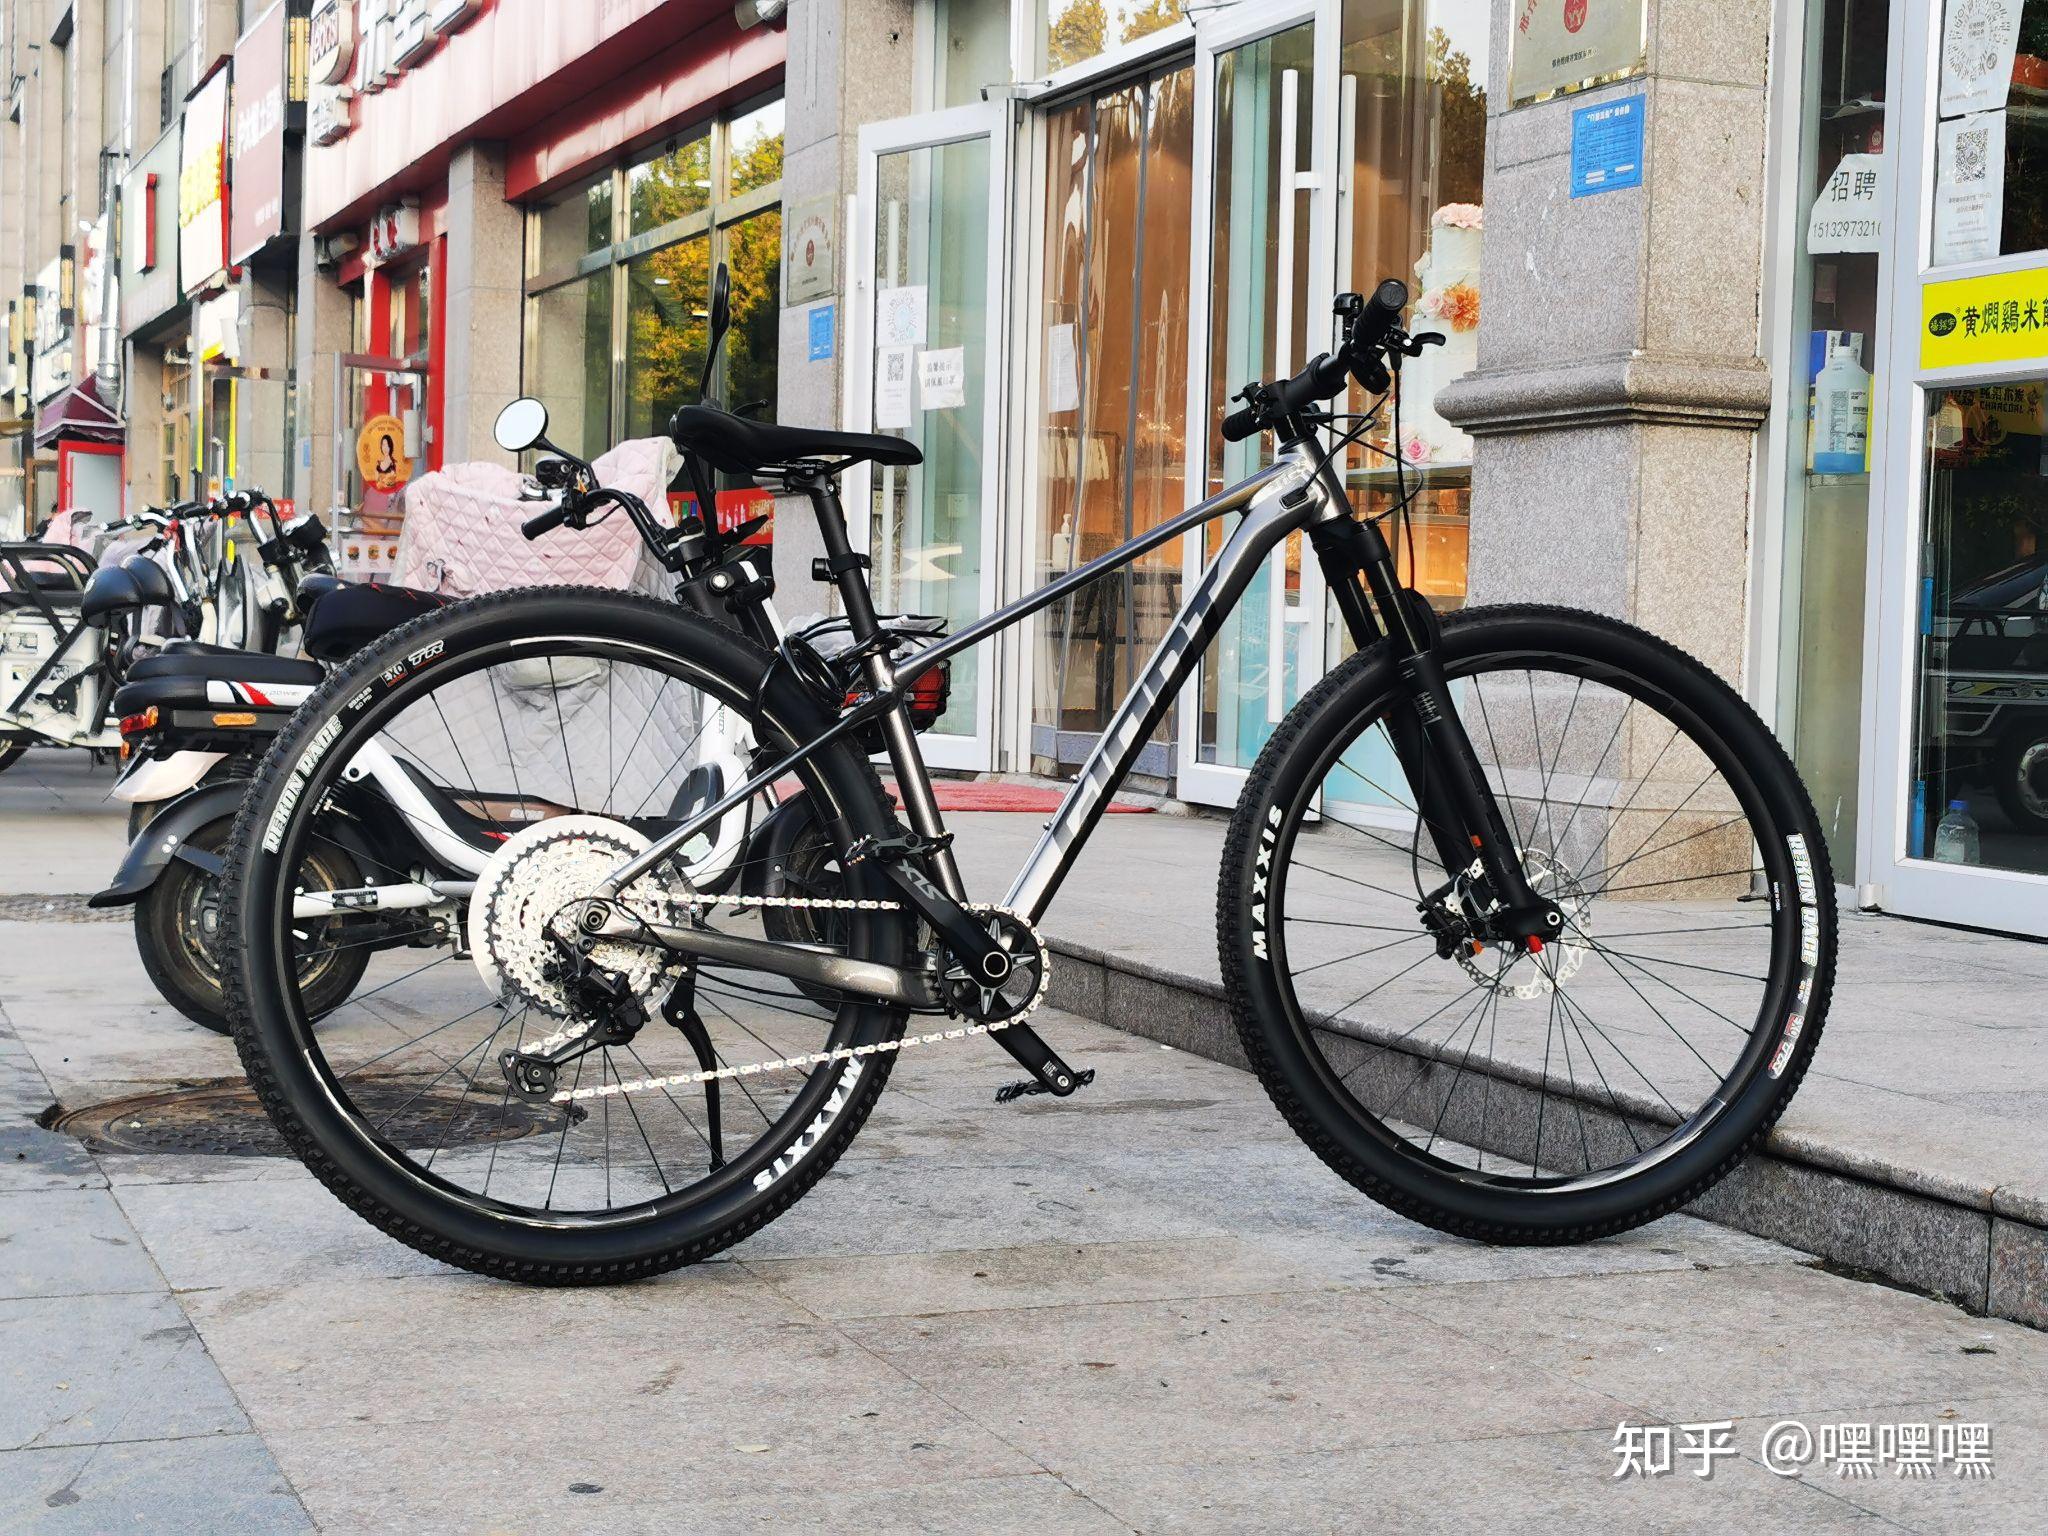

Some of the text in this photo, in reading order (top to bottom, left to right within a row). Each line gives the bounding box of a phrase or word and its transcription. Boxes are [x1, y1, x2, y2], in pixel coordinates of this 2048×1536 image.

[1831, 169, 1877, 202] 招聘
[262, 714, 344, 854] REKON RACE
[1252, 804, 1283, 961] MAXXIS
[1786, 833, 1818, 906] REKON
[1799, 906, 1819, 968] RACE
[752, 1056, 867, 1192] MAXXIS
